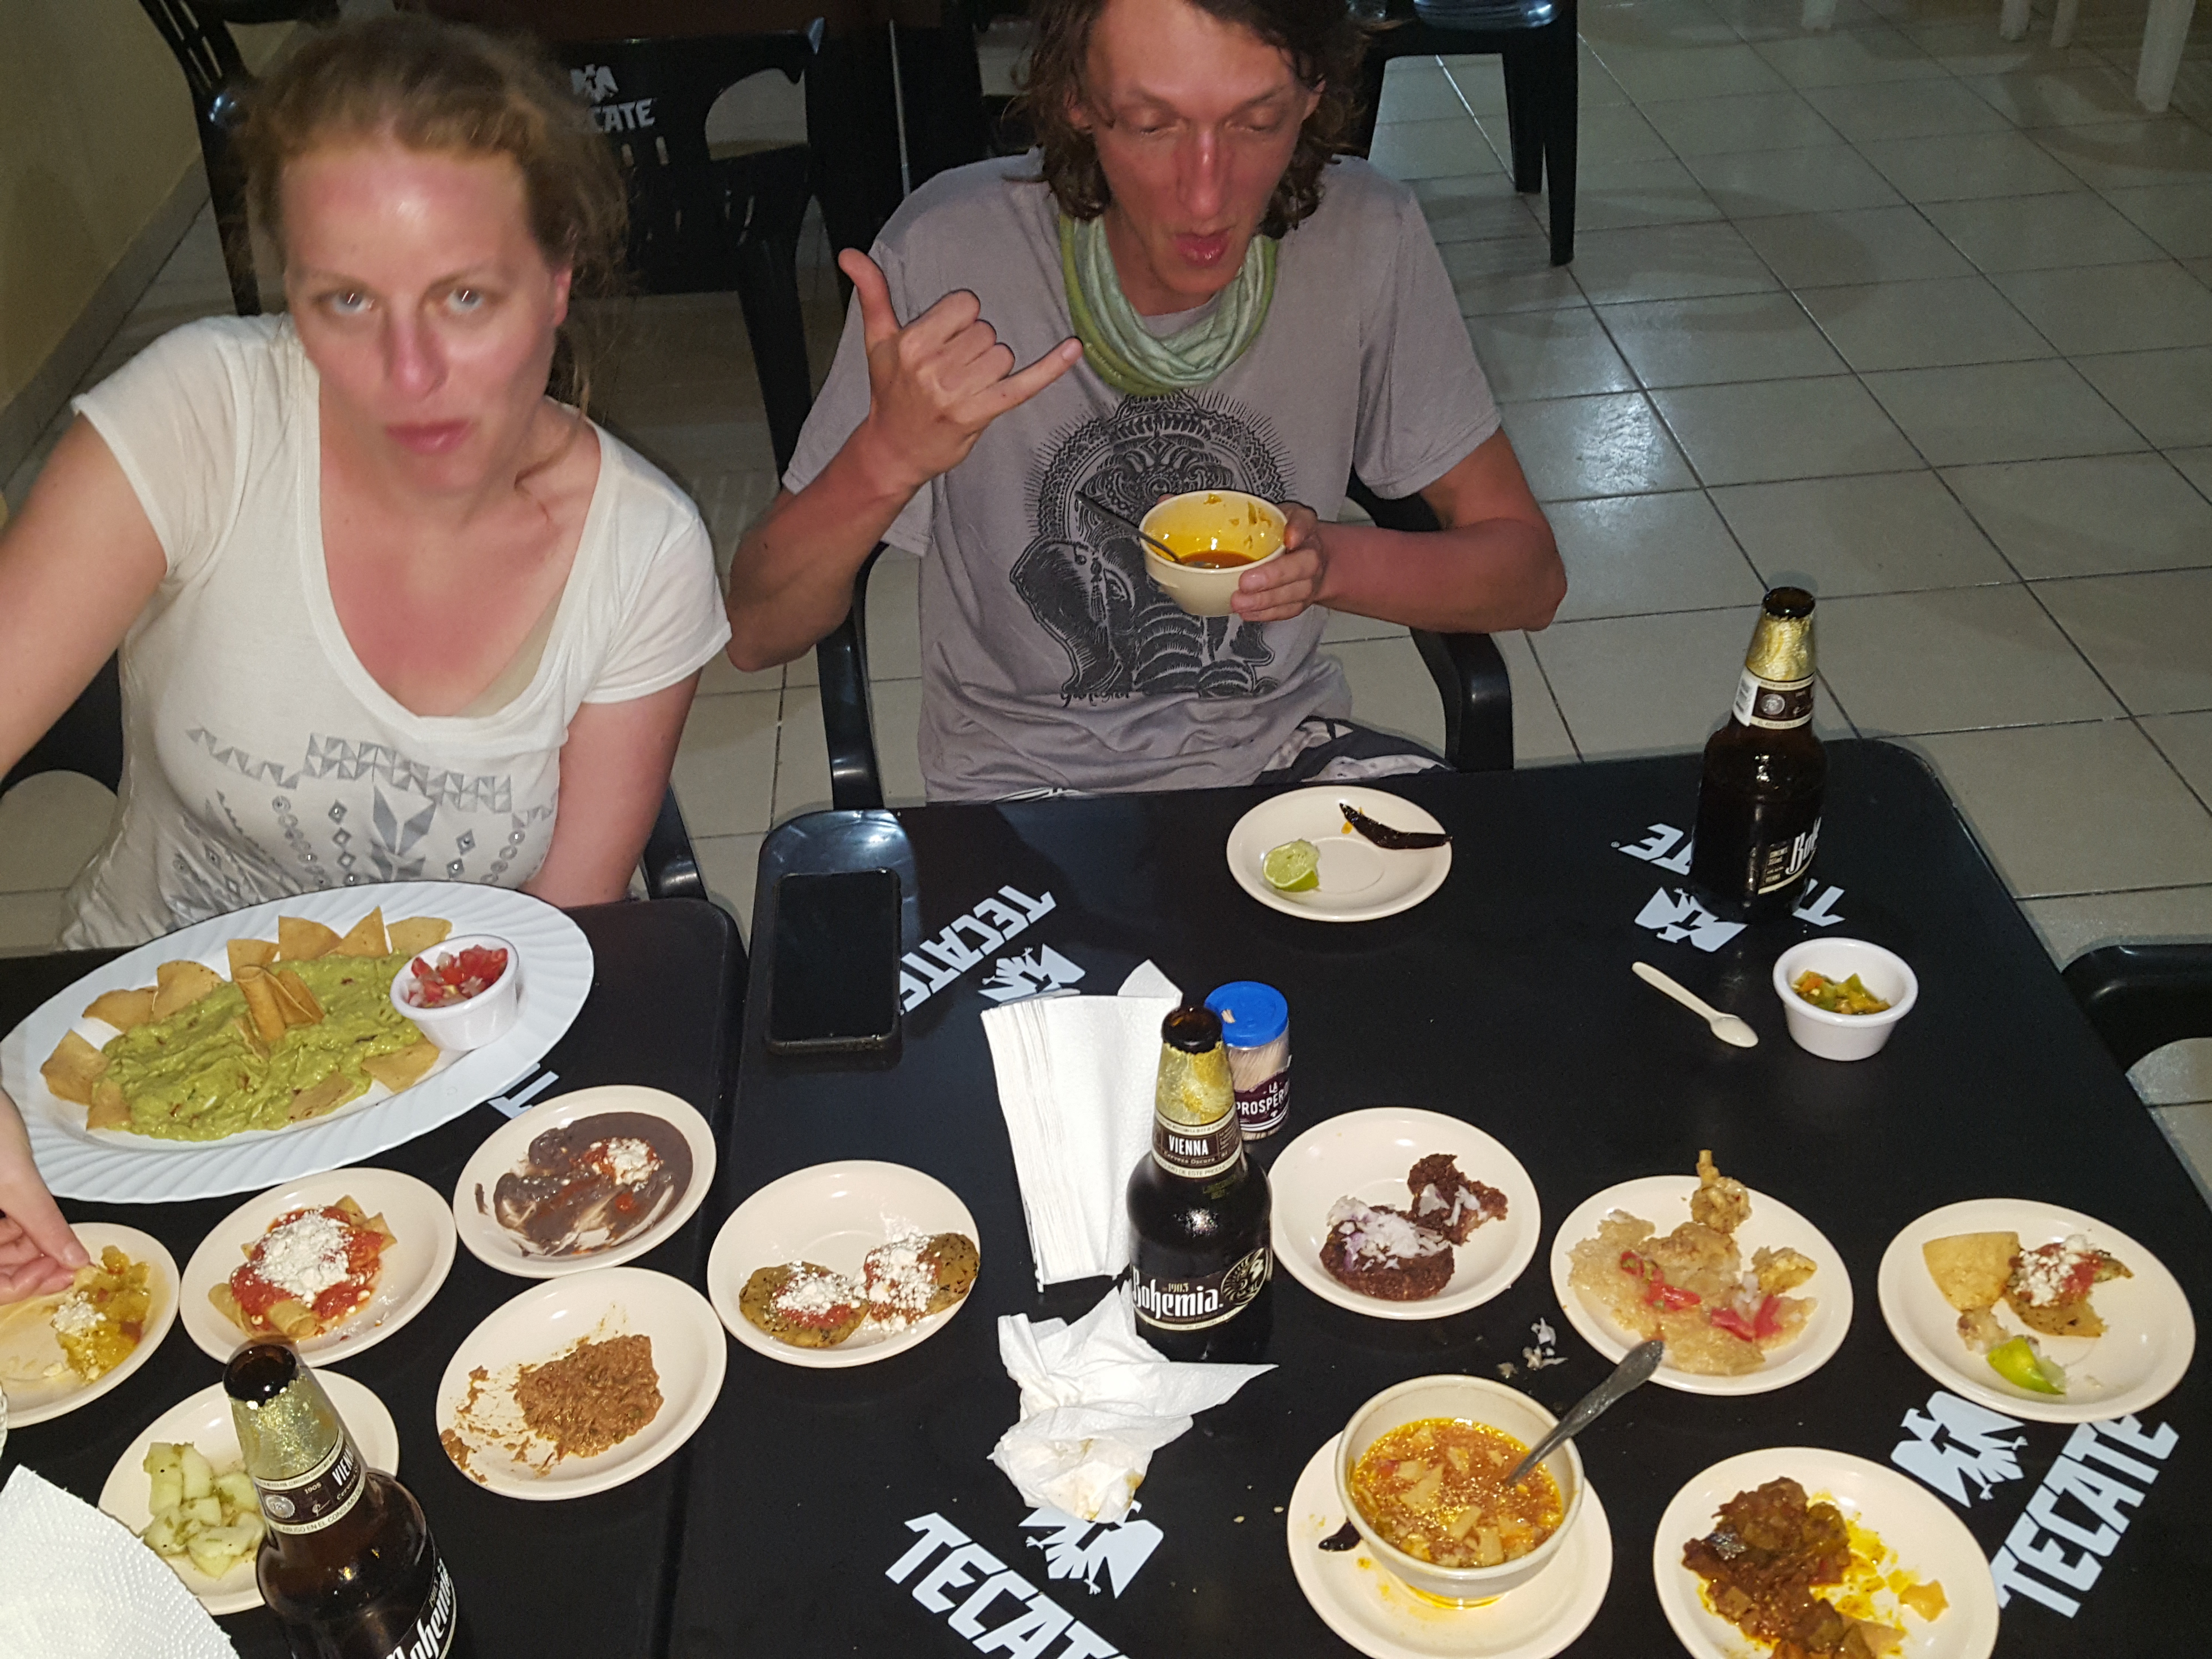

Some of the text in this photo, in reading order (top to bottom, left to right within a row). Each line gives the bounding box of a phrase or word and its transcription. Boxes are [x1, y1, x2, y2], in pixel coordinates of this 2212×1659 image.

[587, 97, 656, 133] CATE
[1269, 1081, 1278, 1094] LA
[1168, 1134, 1209, 1157] VIENNA
[1132, 1265, 1220, 1320] Bohemia
[304, 1482, 322, 1495] 1905
[1989, 1414, 2180, 1618] TECATE
[884, 1511, 1133, 1659] TECAT
